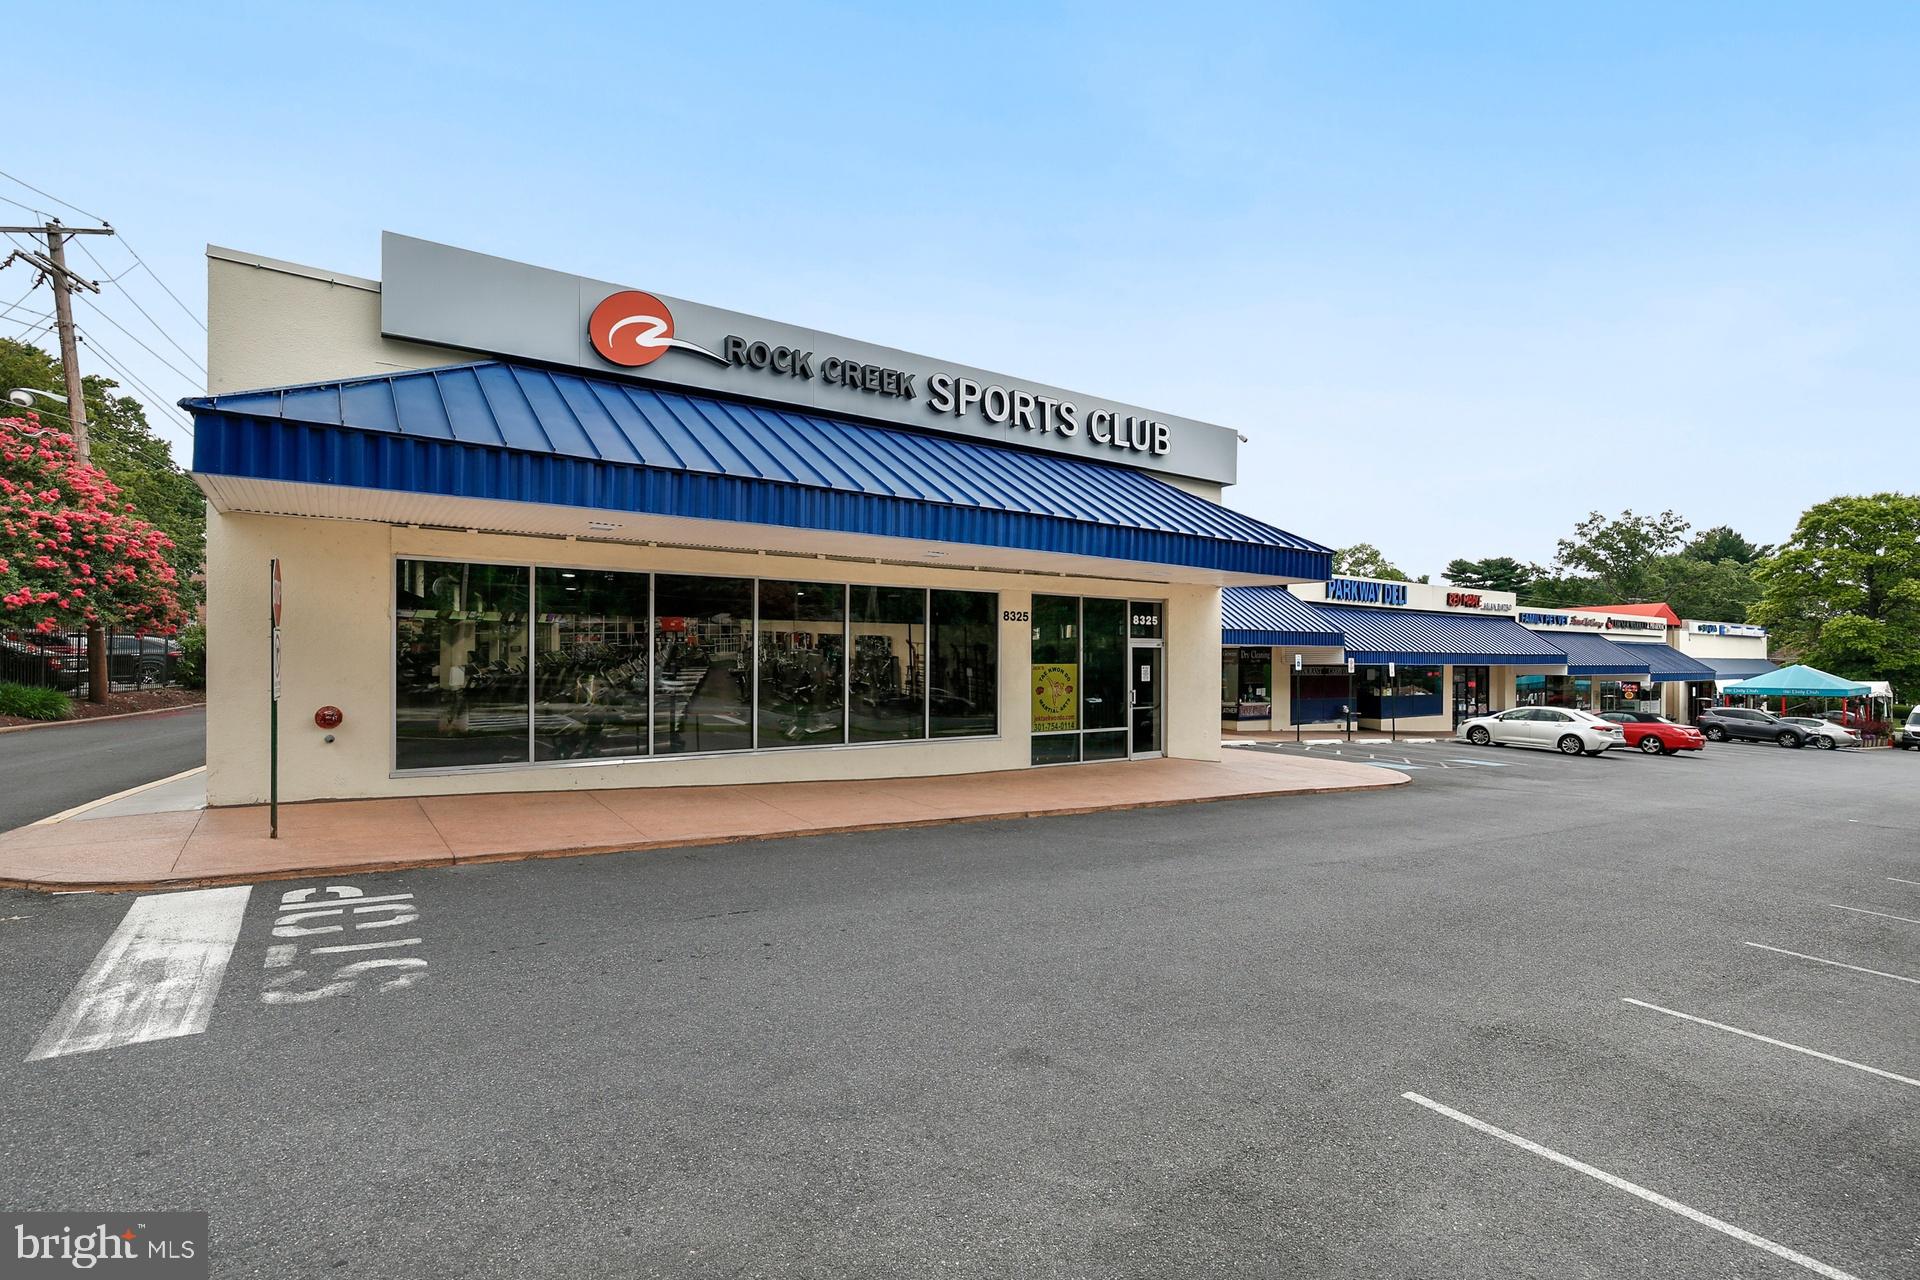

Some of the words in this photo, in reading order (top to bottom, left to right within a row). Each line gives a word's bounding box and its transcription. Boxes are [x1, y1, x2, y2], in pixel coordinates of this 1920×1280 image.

[724, 334, 814, 379] ROCK
[821, 356, 917, 400] CREEK
[927, 372, 1079, 437] SPORTS
[1087, 409, 1172, 455] CLUB
[1326, 579, 1382, 602] PARKWAY
[1382, 584, 1408, 605] DELI
[1003, 611, 1029, 622] 8325
[1133, 615, 1158, 625] 8325
[1519, 613, 1544, 624] FAMILY
[1241, 650, 1250, 659] Dry
[1251, 650, 1271, 659] Cleaning
[1039, 699, 1059, 713] MARTIAL
[1033, 721, 1075, 731] 301-754-0114
[259, 885, 430, 1004] STOP
